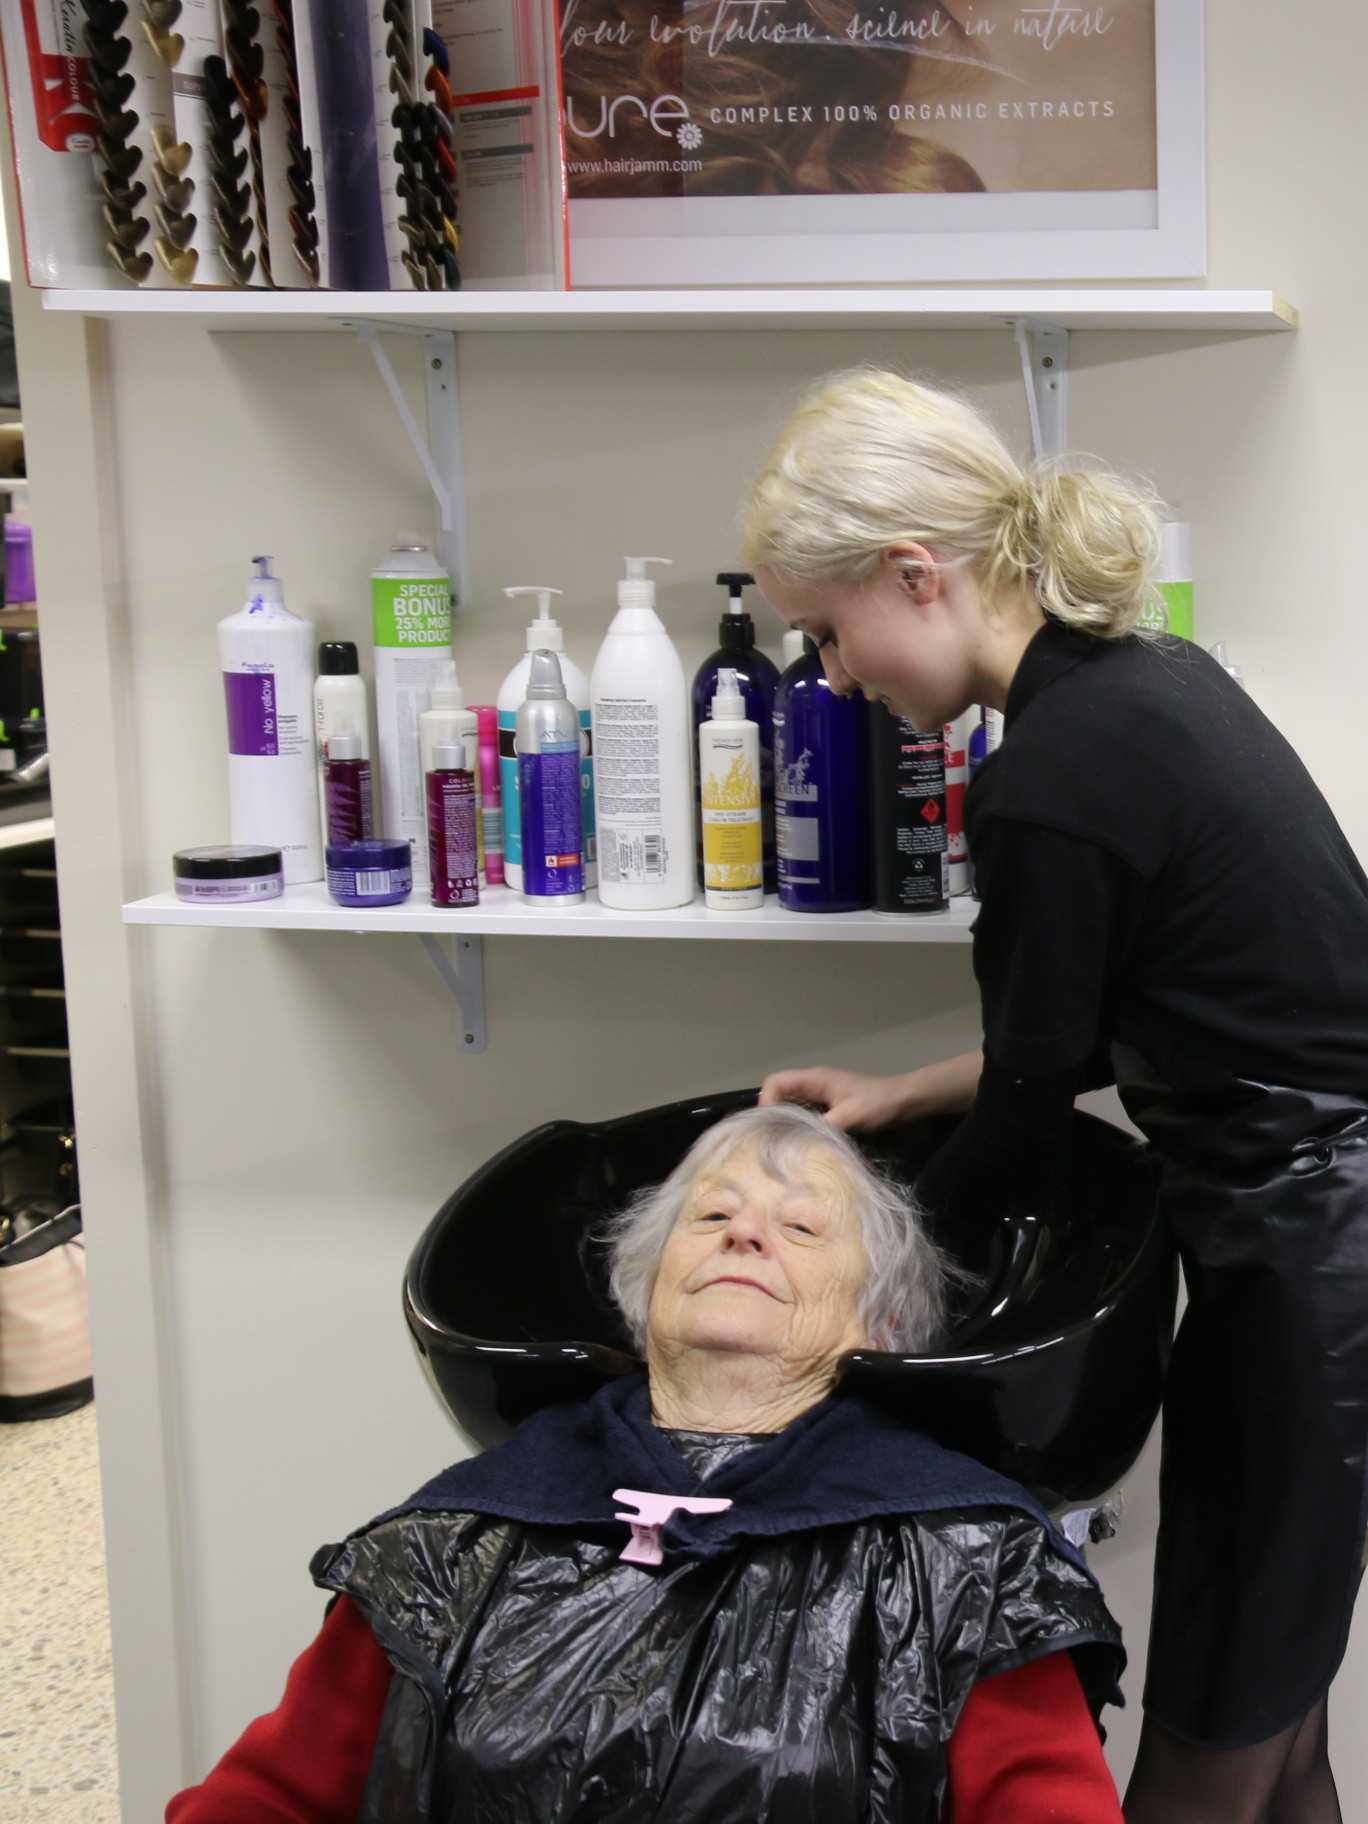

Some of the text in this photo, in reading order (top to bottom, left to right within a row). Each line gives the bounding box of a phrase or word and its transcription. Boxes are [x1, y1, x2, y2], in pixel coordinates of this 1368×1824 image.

[650, 0, 815, 57] evolution
[846, 7, 950, 40] science
[965, 5, 997, 36] in
[1013, 0, 1115, 50] nature
[710, 101, 1114, 124] COMPLEX 100% ORGANIC EXTRACTS
[567, 157, 702, 175] www.hairjamm.com
[398, 629, 450, 642] PRODUC
[261, 679, 275, 734] No yellow
